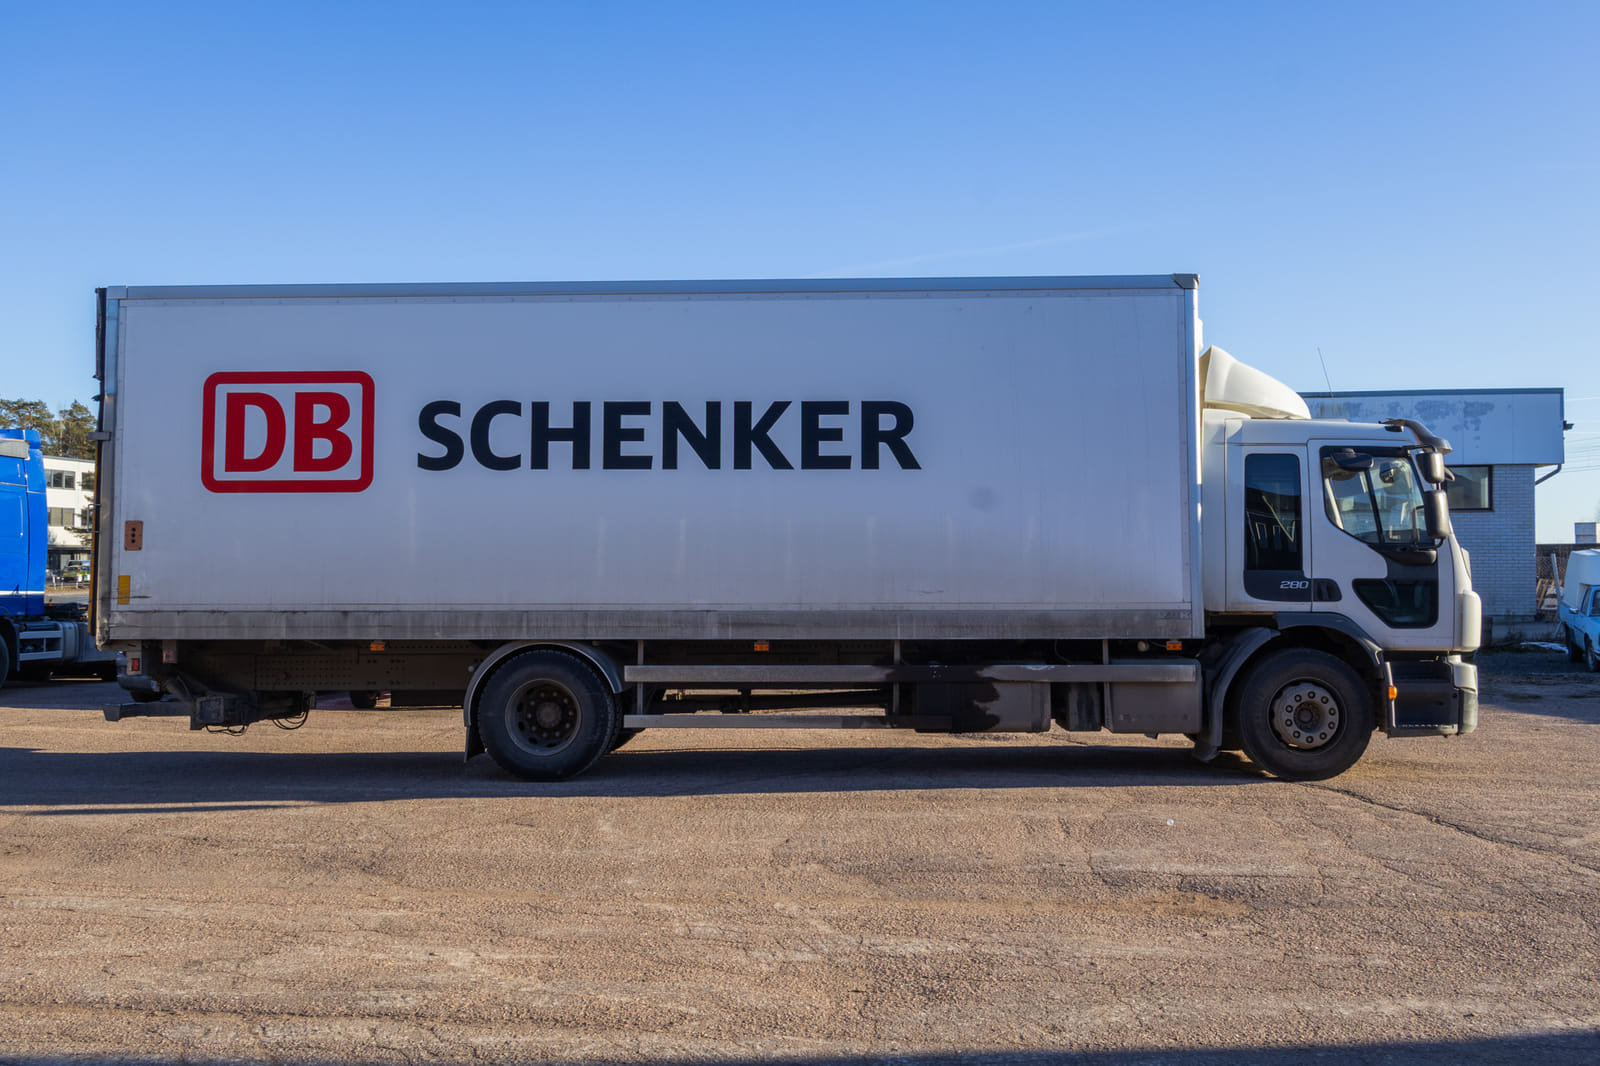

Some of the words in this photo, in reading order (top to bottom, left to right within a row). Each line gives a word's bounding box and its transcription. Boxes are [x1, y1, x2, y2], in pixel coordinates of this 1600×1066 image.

[225, 392, 353, 472] DB
[417, 399, 921, 470] SCHENKER
[1279, 580, 1309, 589] 280
